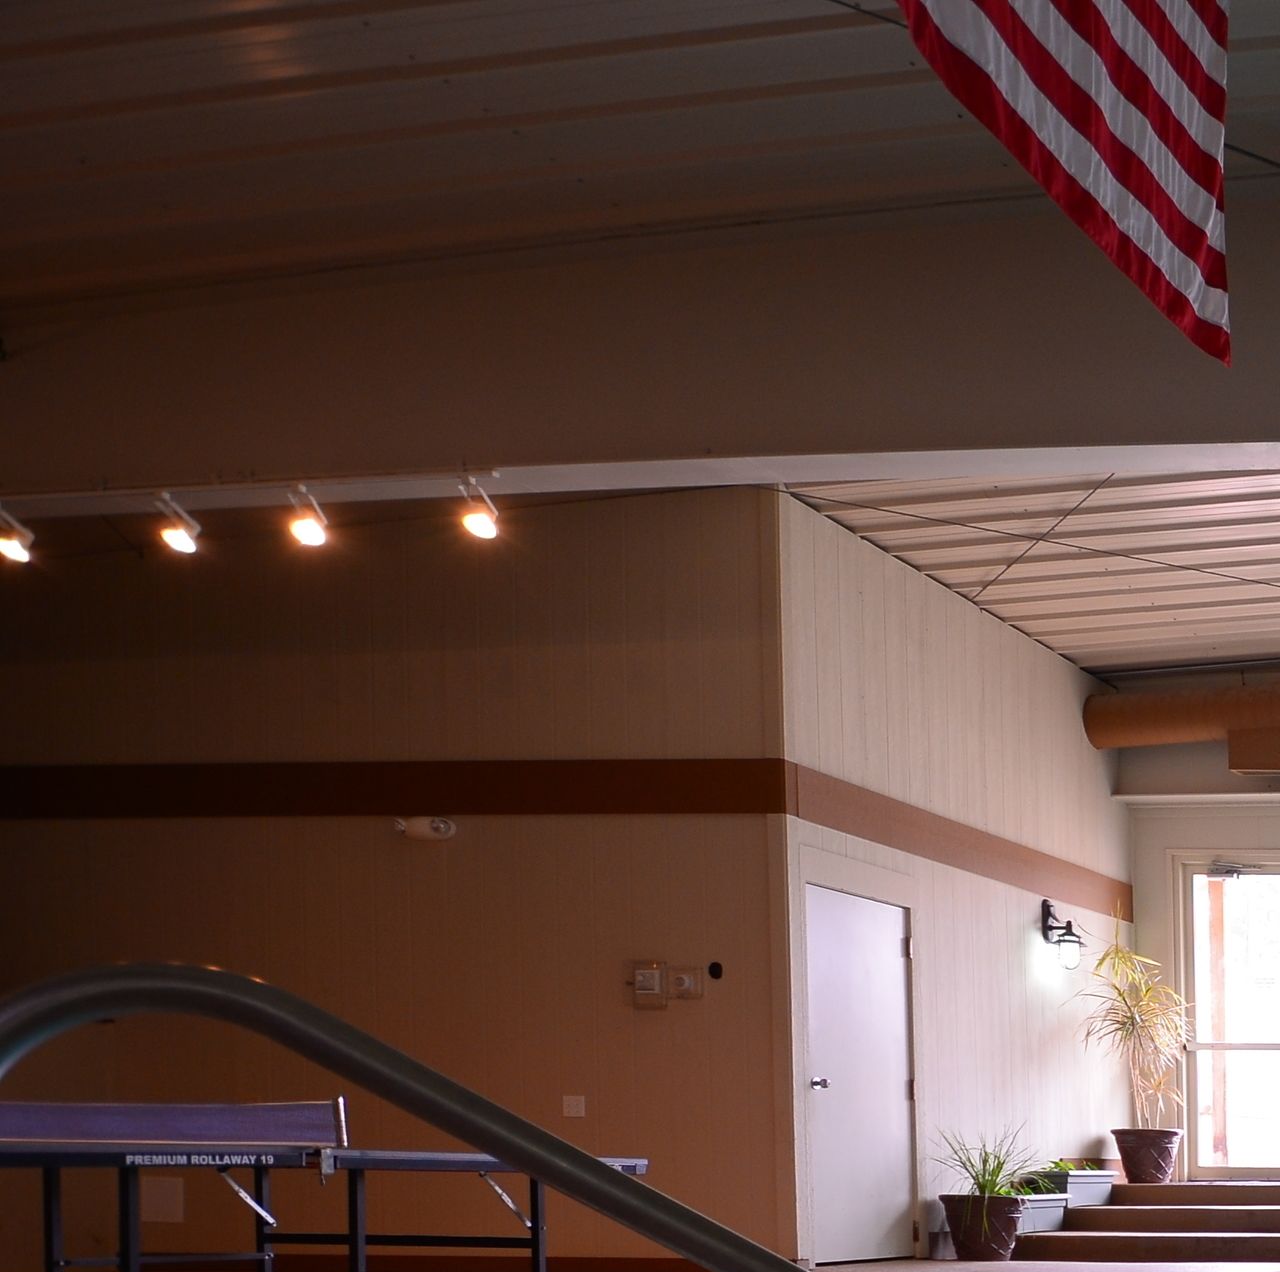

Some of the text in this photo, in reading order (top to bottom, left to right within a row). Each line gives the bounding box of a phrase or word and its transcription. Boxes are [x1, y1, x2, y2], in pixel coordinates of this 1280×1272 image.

[125, 1155, 274, 1165] PREMIUM ROLLAWAY 19
